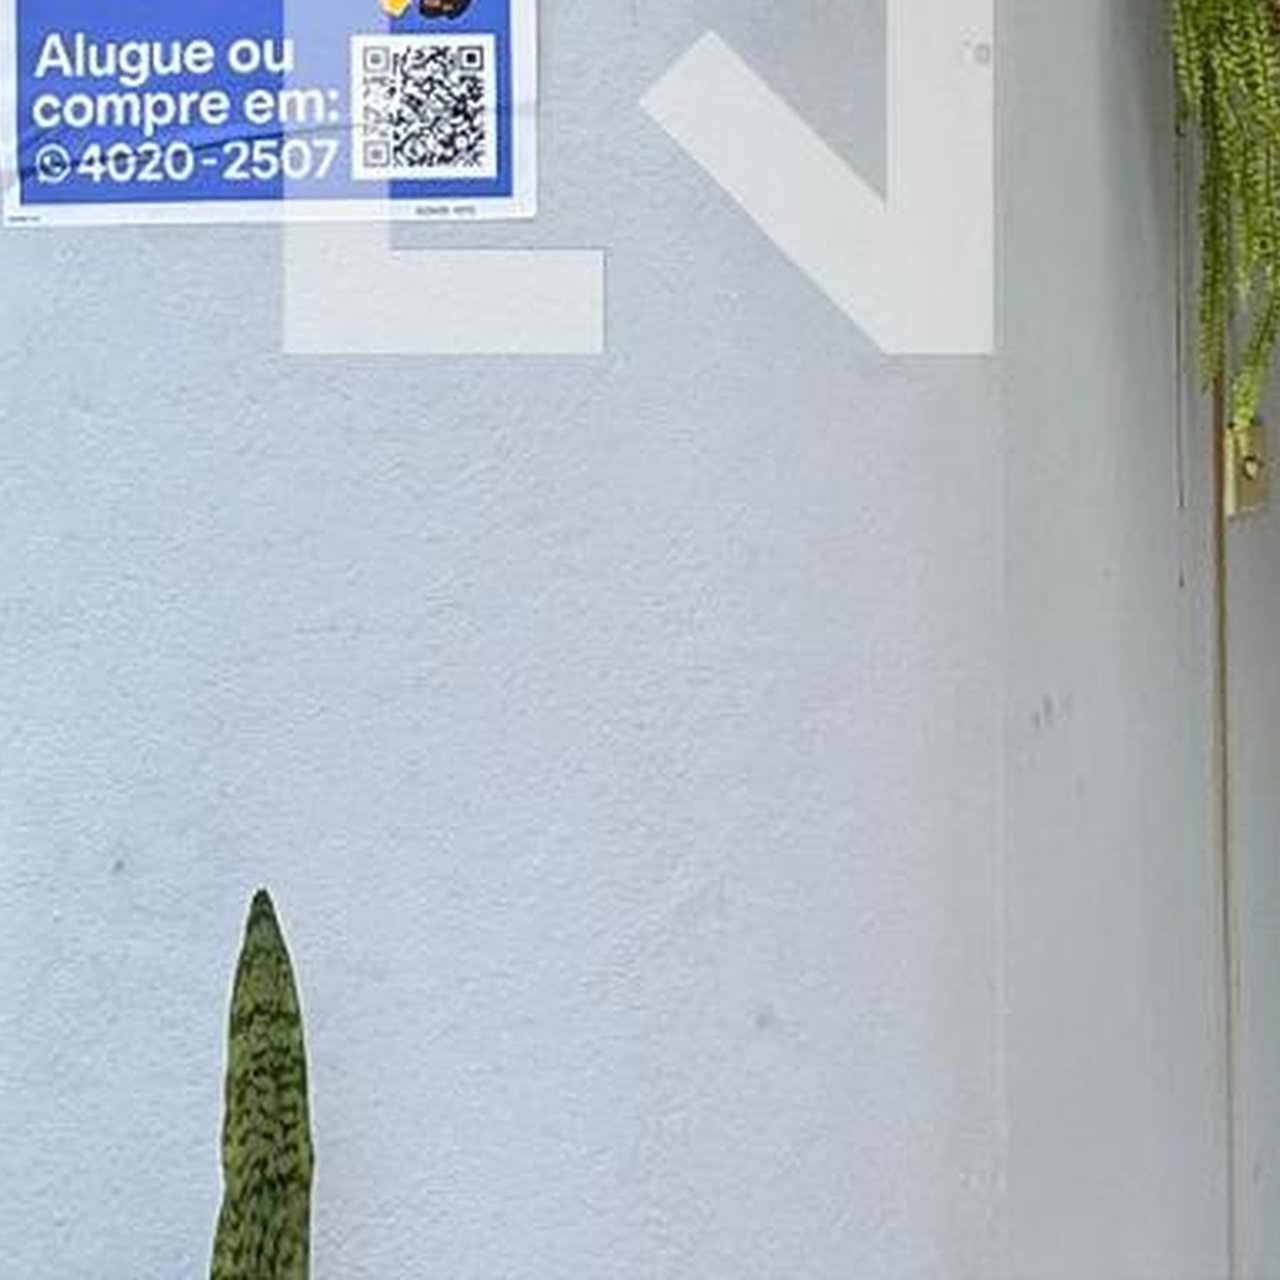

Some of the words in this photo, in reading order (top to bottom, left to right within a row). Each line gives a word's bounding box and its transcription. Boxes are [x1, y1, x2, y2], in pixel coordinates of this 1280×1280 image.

[34, 33, 215, 87] Alugue
[228, 37, 294, 74] ou
[32, 89, 230, 136] compre
[244, 85, 339, 123] em:
[77, 139, 338, 181] 4020-2507
